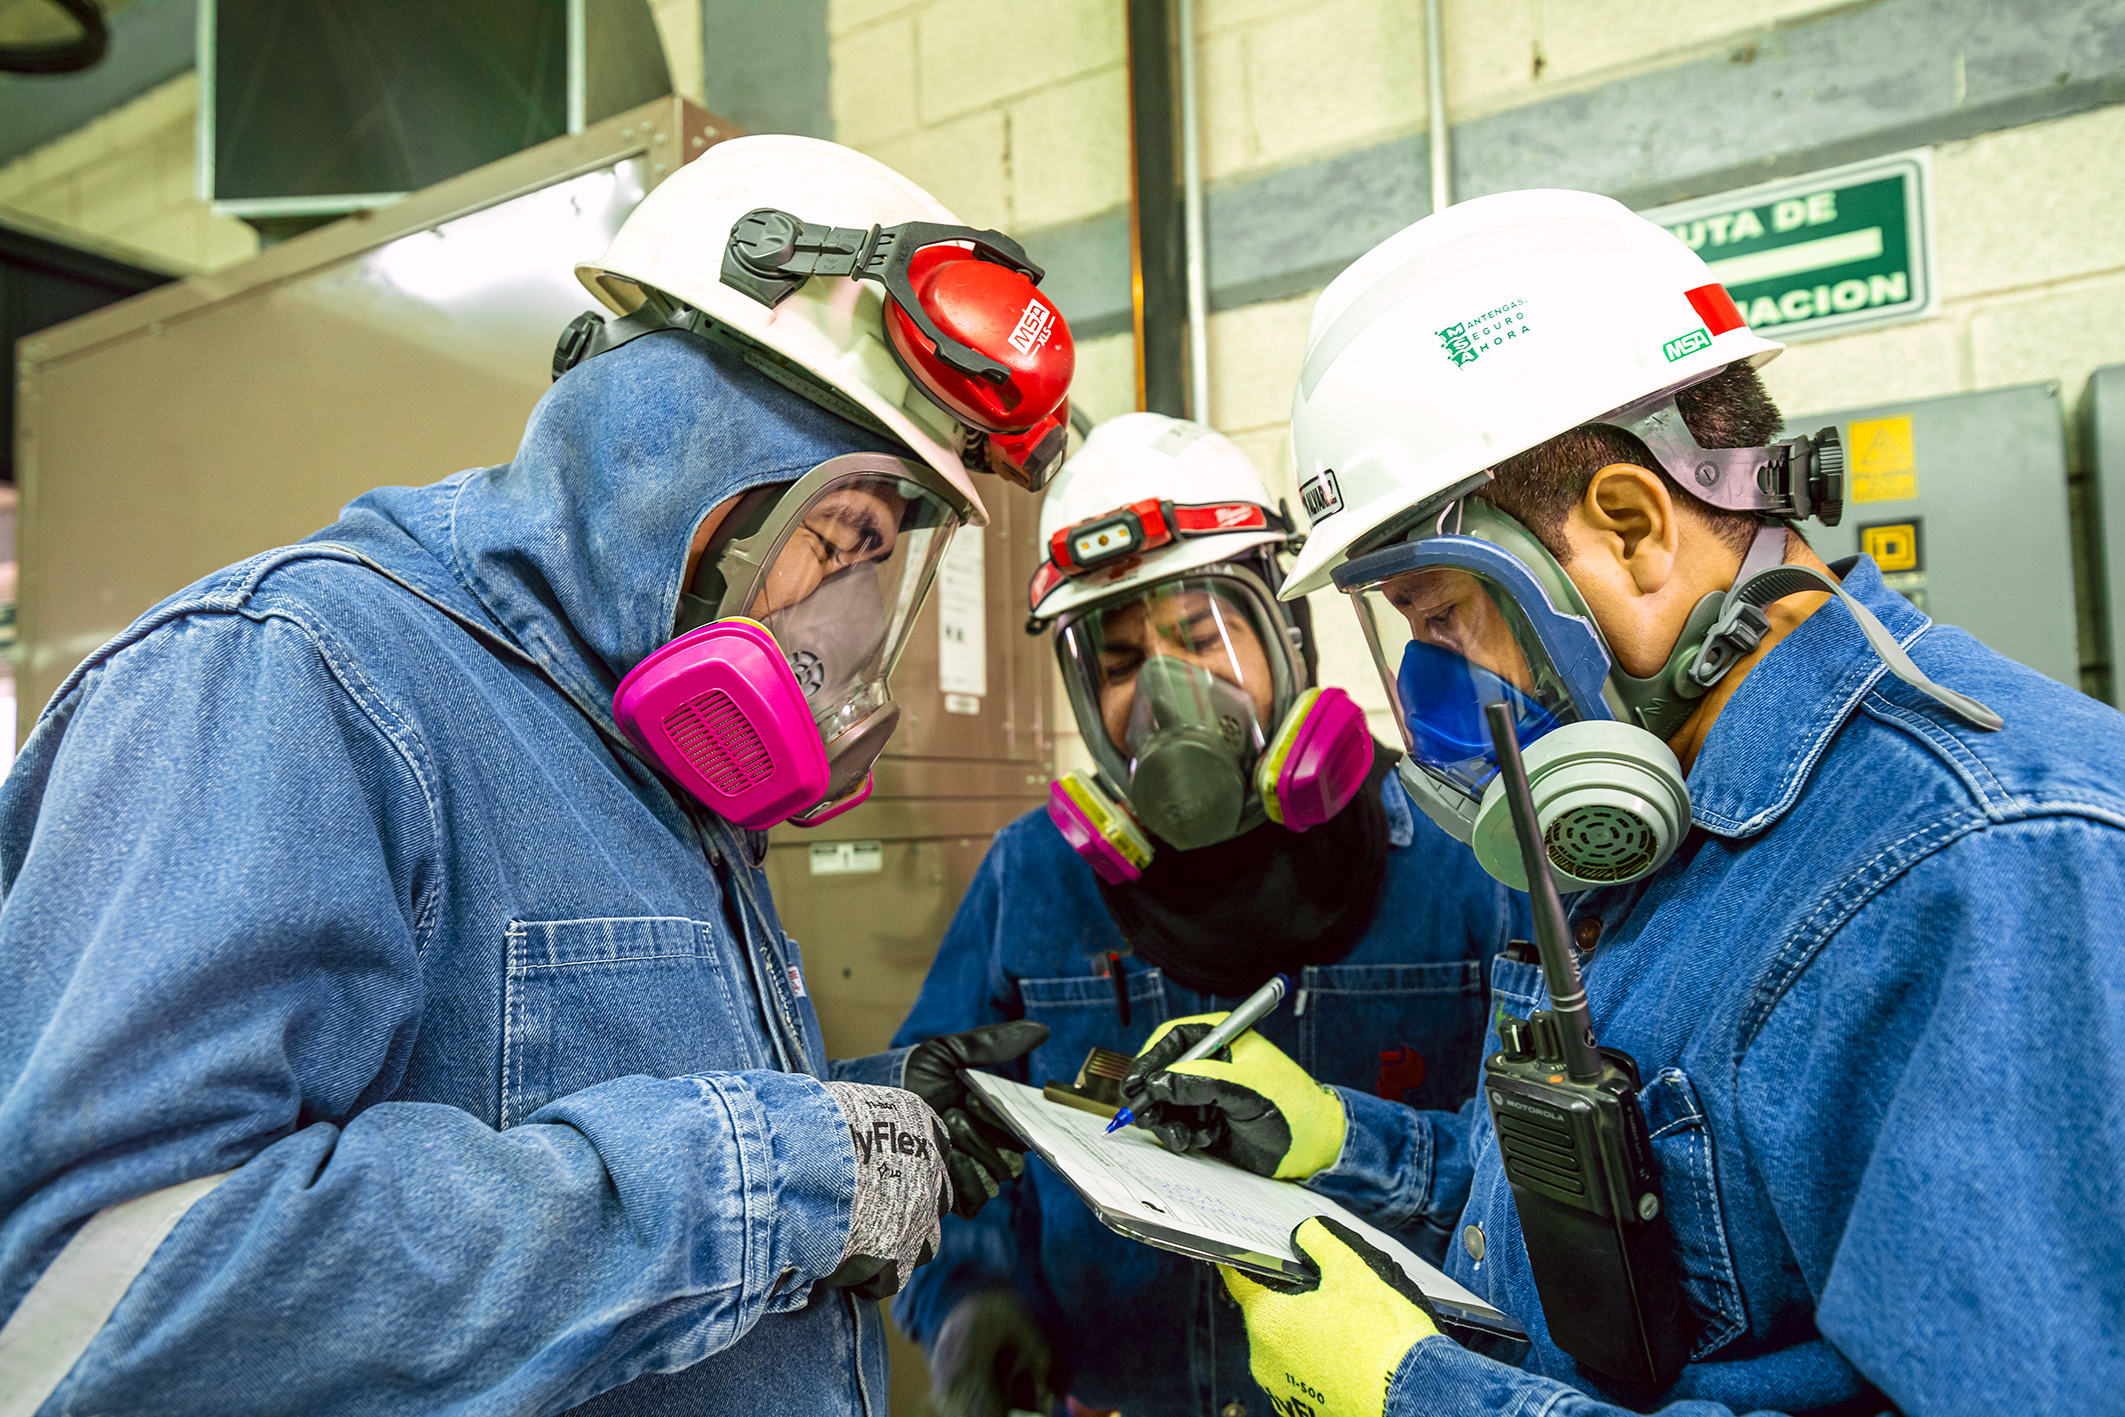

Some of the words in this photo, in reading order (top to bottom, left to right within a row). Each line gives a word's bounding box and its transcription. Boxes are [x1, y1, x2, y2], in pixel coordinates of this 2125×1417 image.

[1668, 206, 1766, 249] UTA
[1772, 191, 1838, 233] DE
[1010, 301, 1048, 352] MSA
[1036, 326, 1052, 347] XLS
[1663, 330, 1711, 361] MSA
[1506, 1099, 1565, 1122] MOTOROLA
[1285, 1372, 1325, 1405] 11-500
